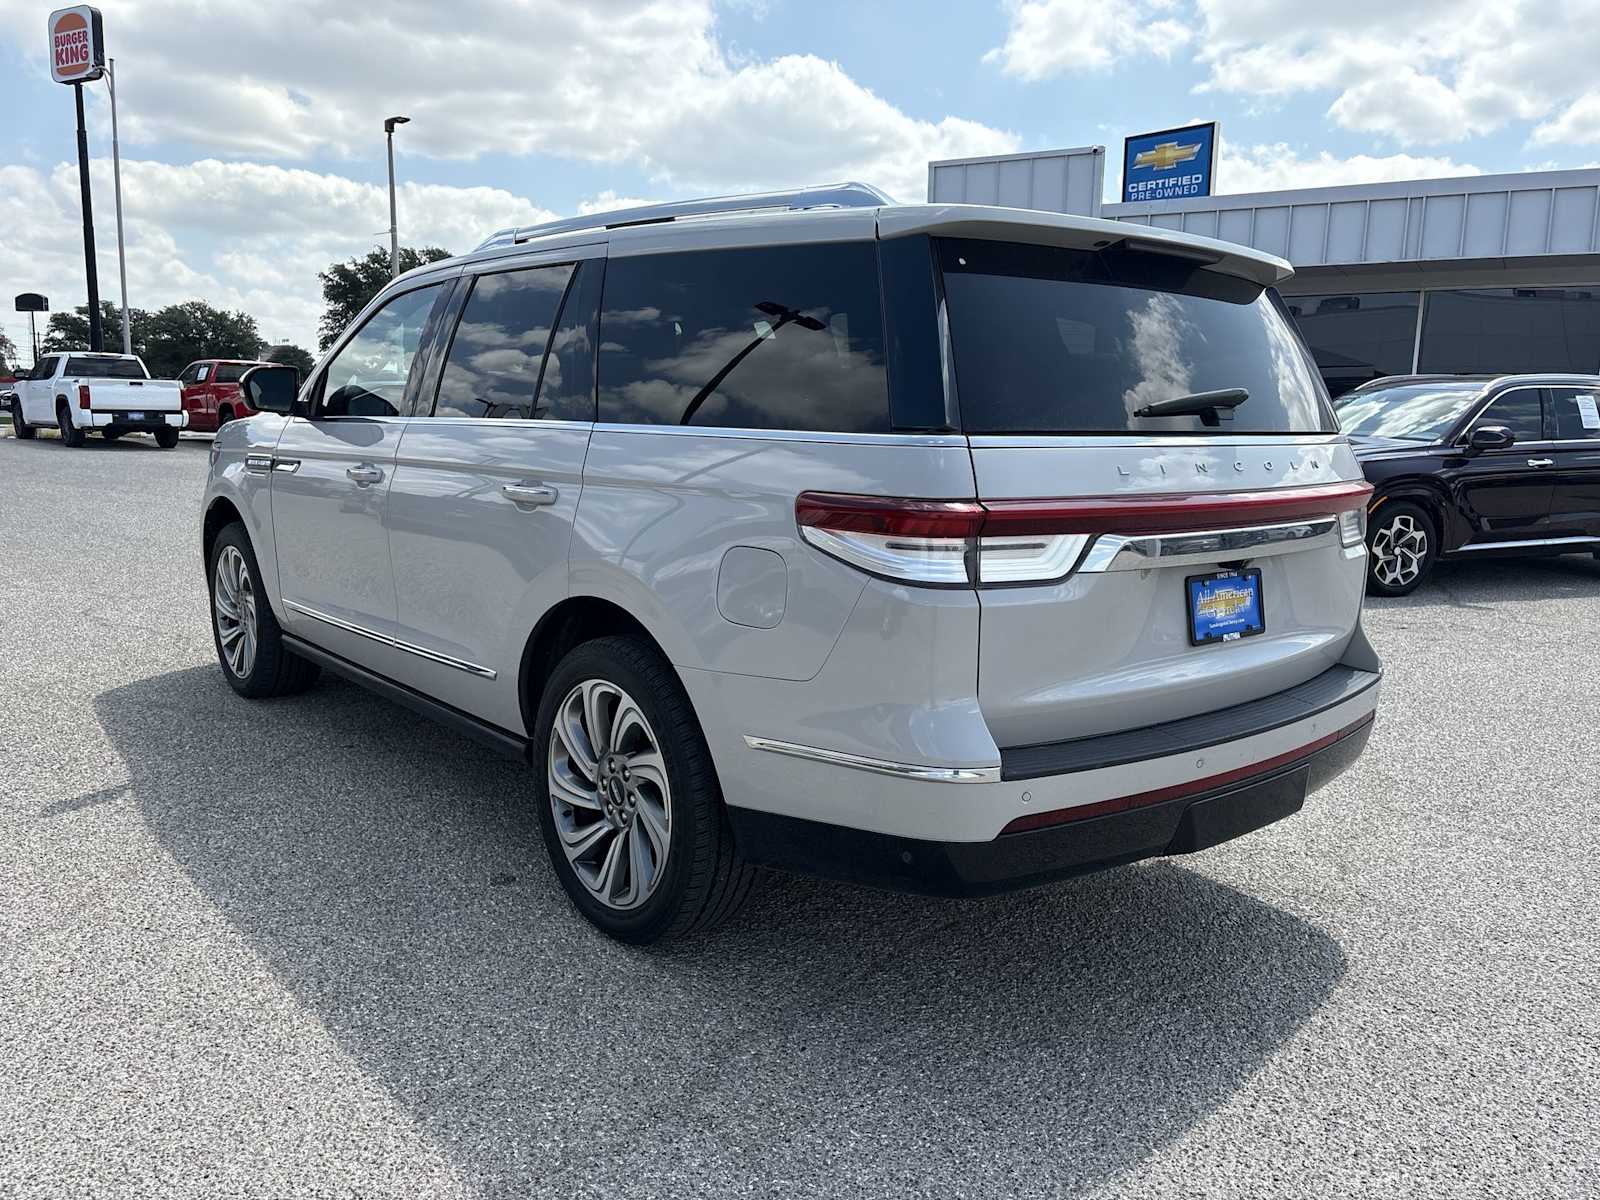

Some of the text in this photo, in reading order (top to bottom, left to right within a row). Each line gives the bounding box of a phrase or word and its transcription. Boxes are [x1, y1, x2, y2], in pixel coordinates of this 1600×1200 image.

[54, 30, 88, 48] BURGER
[55, 43, 89, 66] KING
[1128, 174, 1203, 193] CERTIFIED
[1131, 185, 1198, 200] PRE-OWNED
[1117, 460, 1320, 476] LINCOLN
[1211, 586, 1254, 601] American
